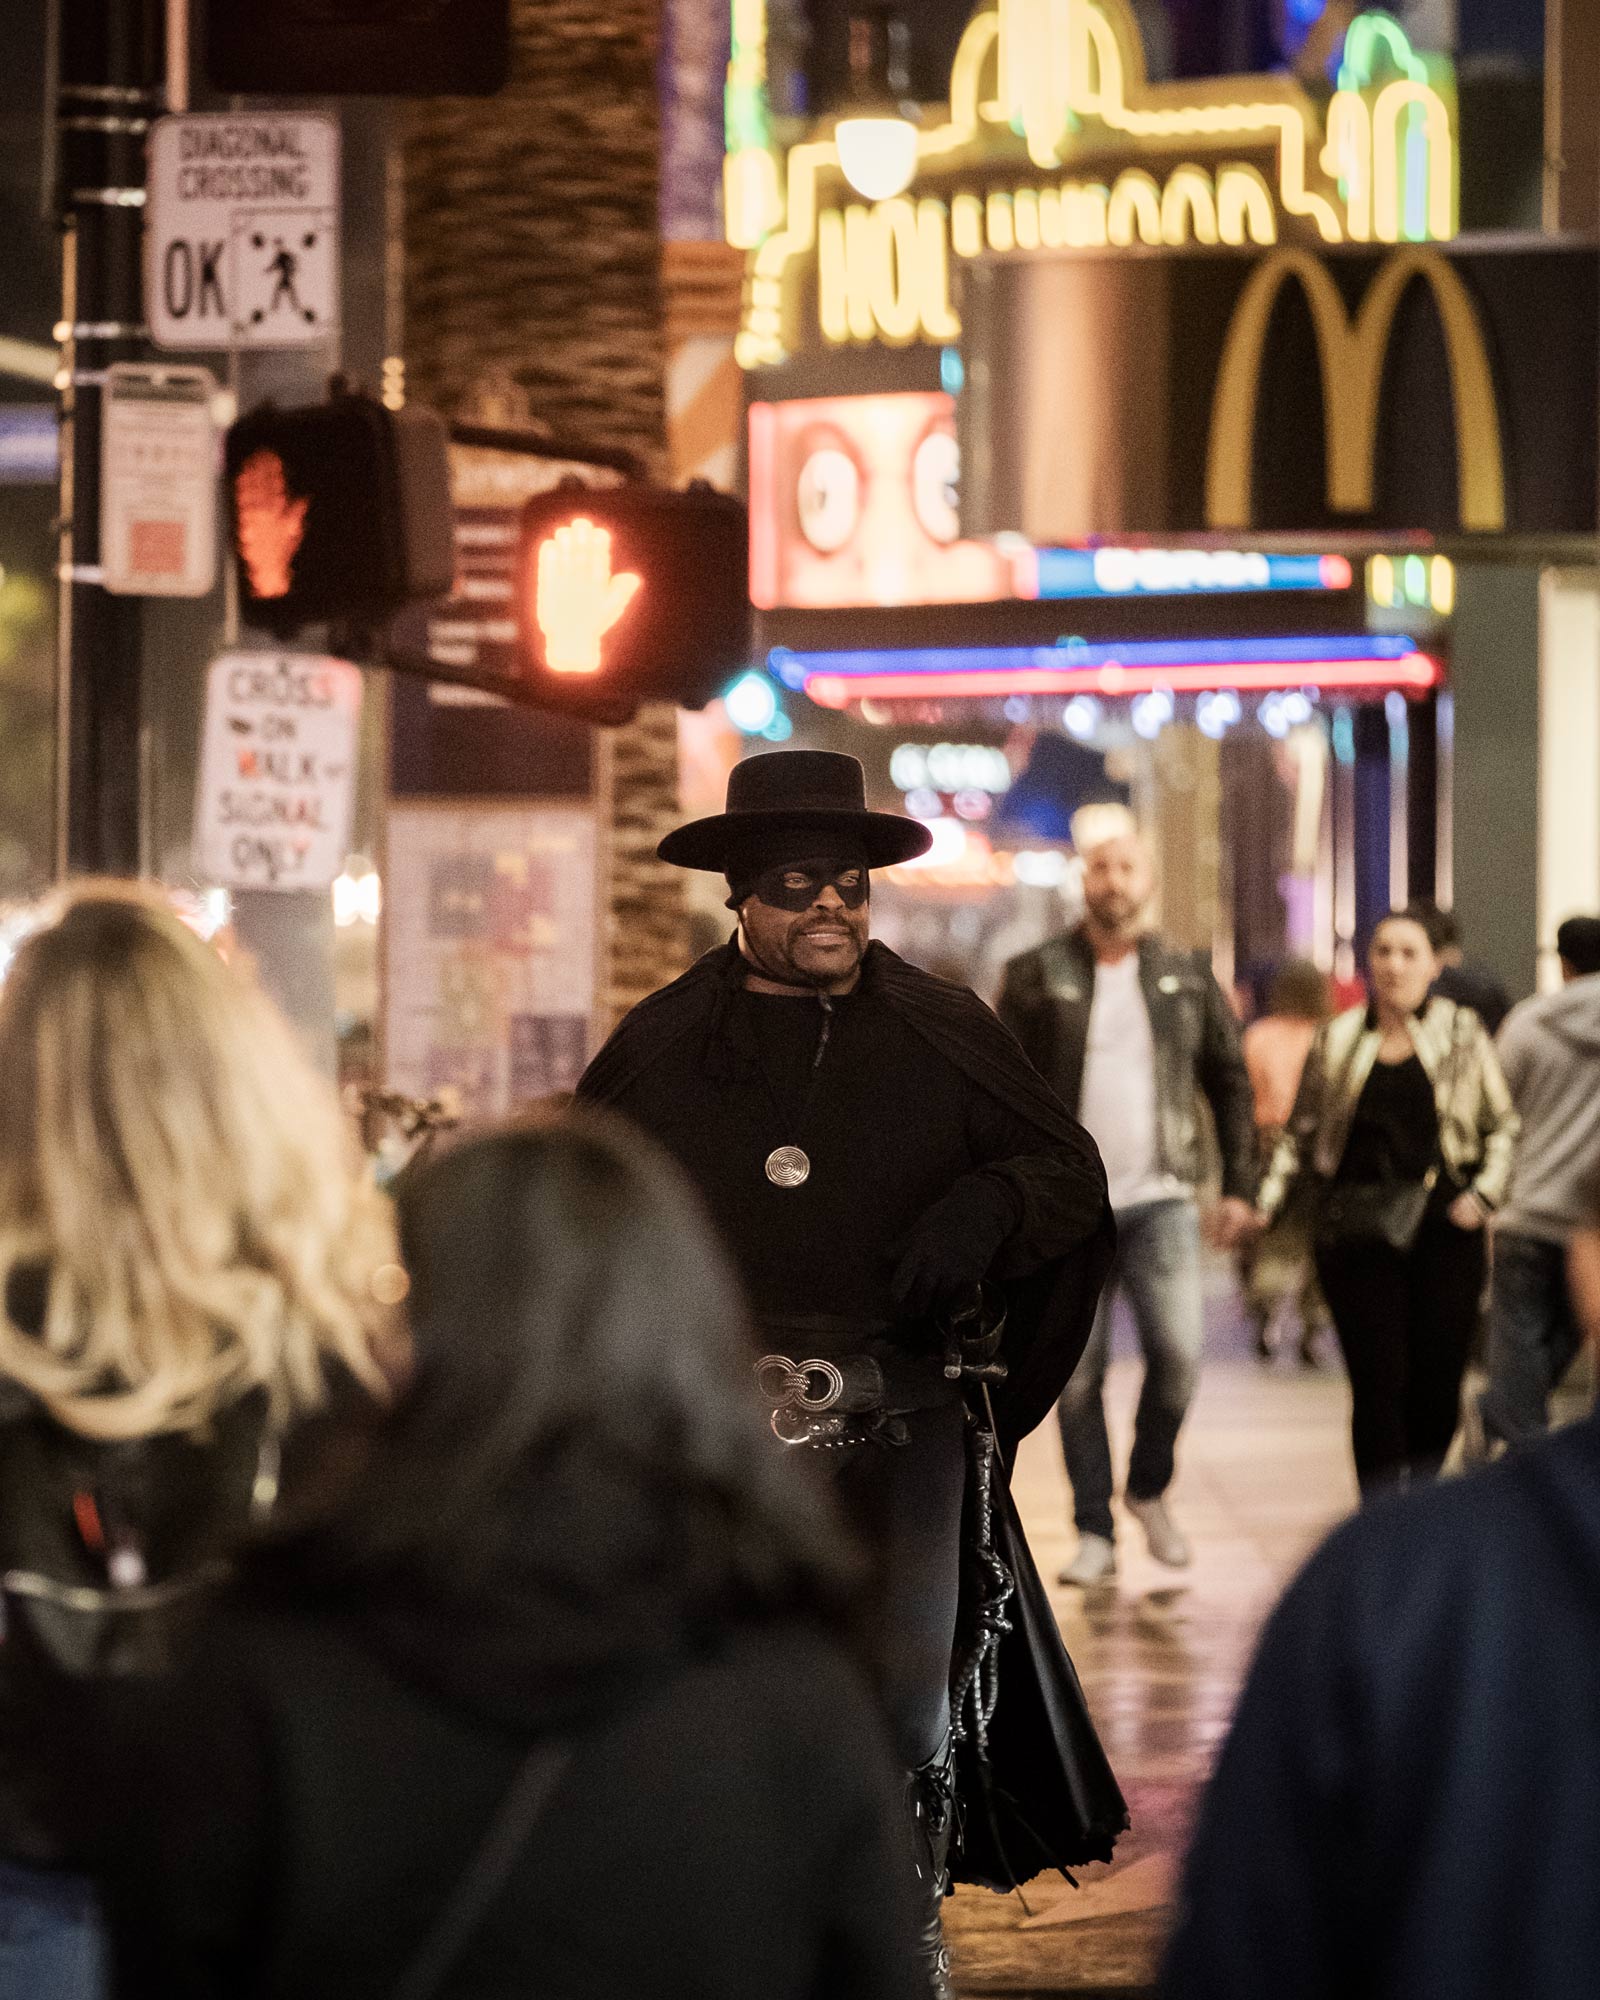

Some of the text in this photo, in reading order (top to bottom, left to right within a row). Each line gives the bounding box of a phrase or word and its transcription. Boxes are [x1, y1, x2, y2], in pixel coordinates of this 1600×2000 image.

[180, 127, 306, 160] DIAGONAL
[177, 166, 310, 199] CROSSING
[164, 239, 225, 319] OK
[227, 670, 333, 708] CROSS
[261, 714, 296, 740] ON
[218, 791, 328, 829] SIGNAL
[232, 835, 310, 870] ONLY
